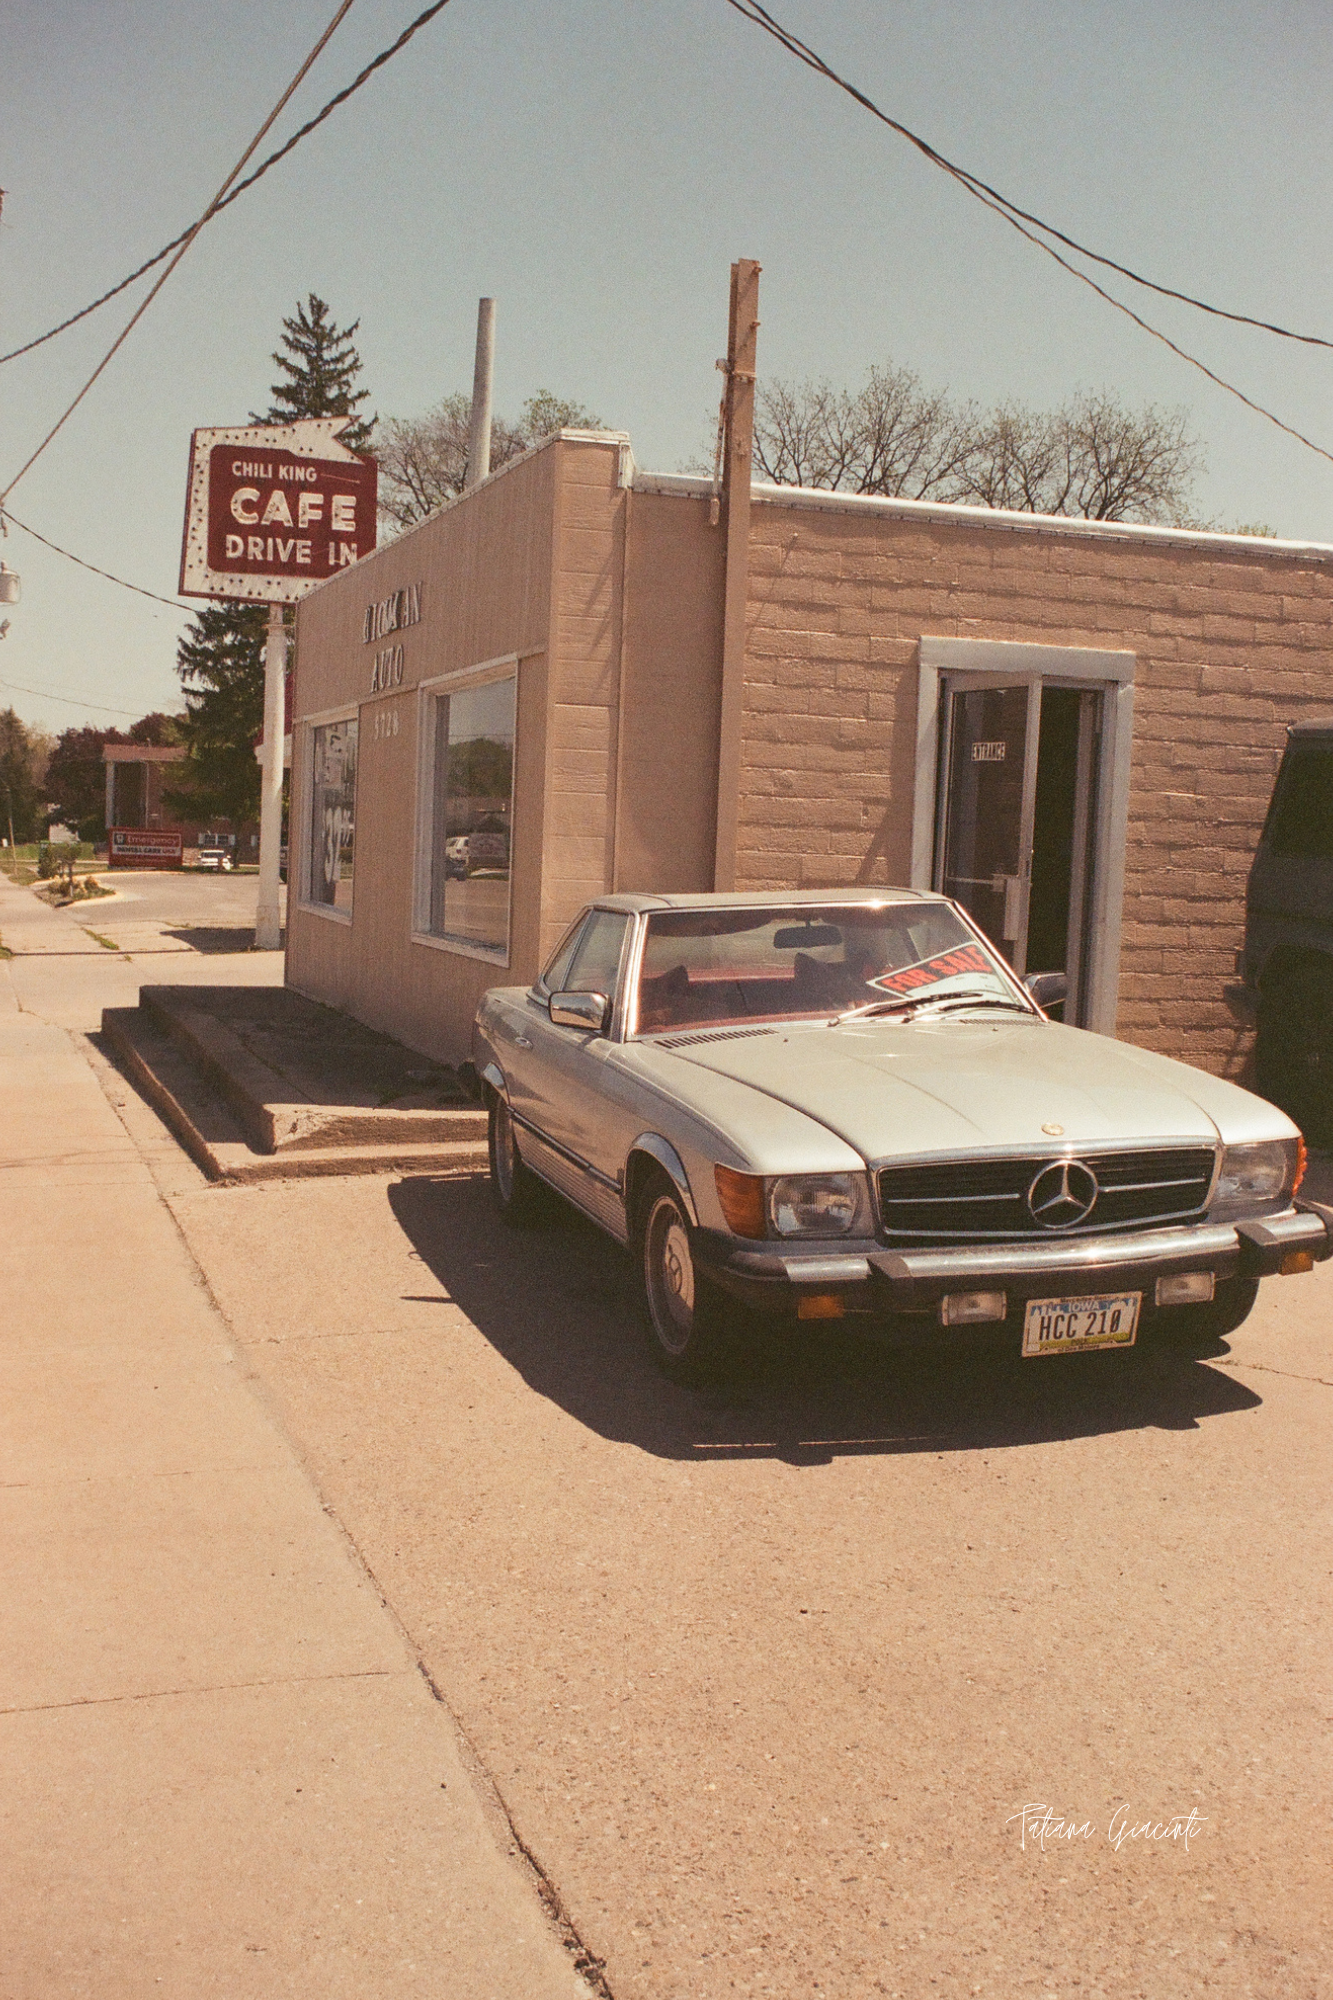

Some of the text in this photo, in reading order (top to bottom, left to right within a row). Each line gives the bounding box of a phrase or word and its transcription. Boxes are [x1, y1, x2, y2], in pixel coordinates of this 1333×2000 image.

[231, 460, 317, 482] CHILI KING
[230, 486, 357, 532] CAFE
[225, 534, 358, 566] DRIVE IN
[370, 643, 404, 694] AUTO
[972, 743, 1004, 759] ENTRANCE
[127, 835, 177, 845] Emergency
[881, 946, 992, 992] FOR SALE
[1068, 1300, 1100, 1312] IOWA
[1040, 1309, 1121, 1340] HCC 210
